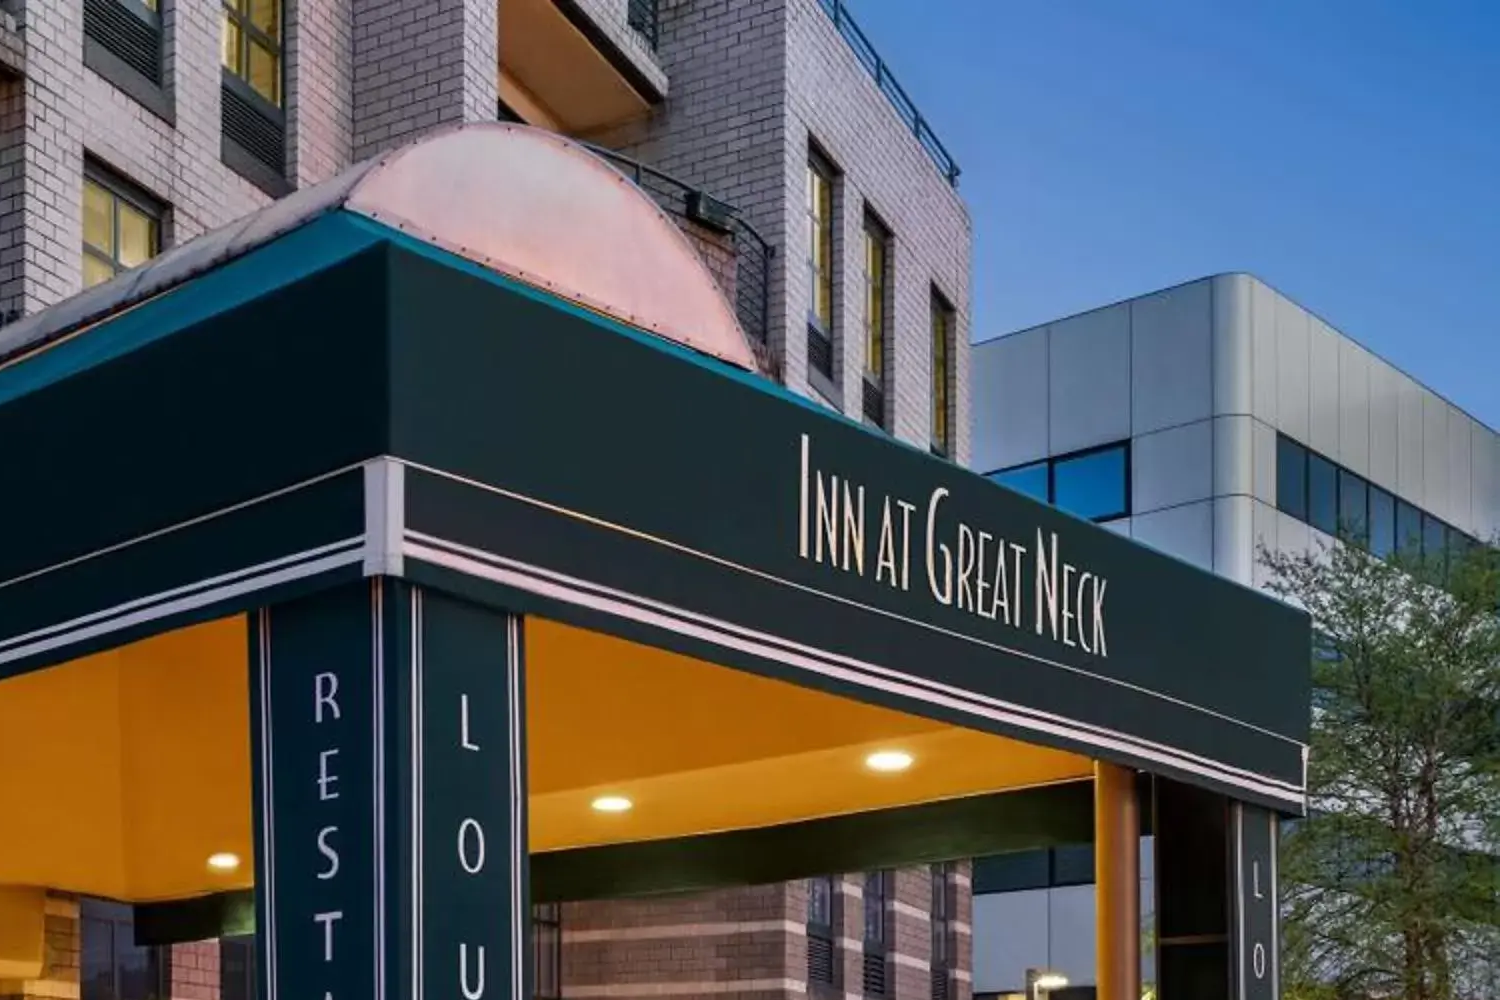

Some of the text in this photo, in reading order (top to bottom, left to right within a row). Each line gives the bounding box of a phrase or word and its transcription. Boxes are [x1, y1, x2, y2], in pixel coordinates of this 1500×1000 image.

[800, 433, 1108, 657] INN AT GREAT NECK
